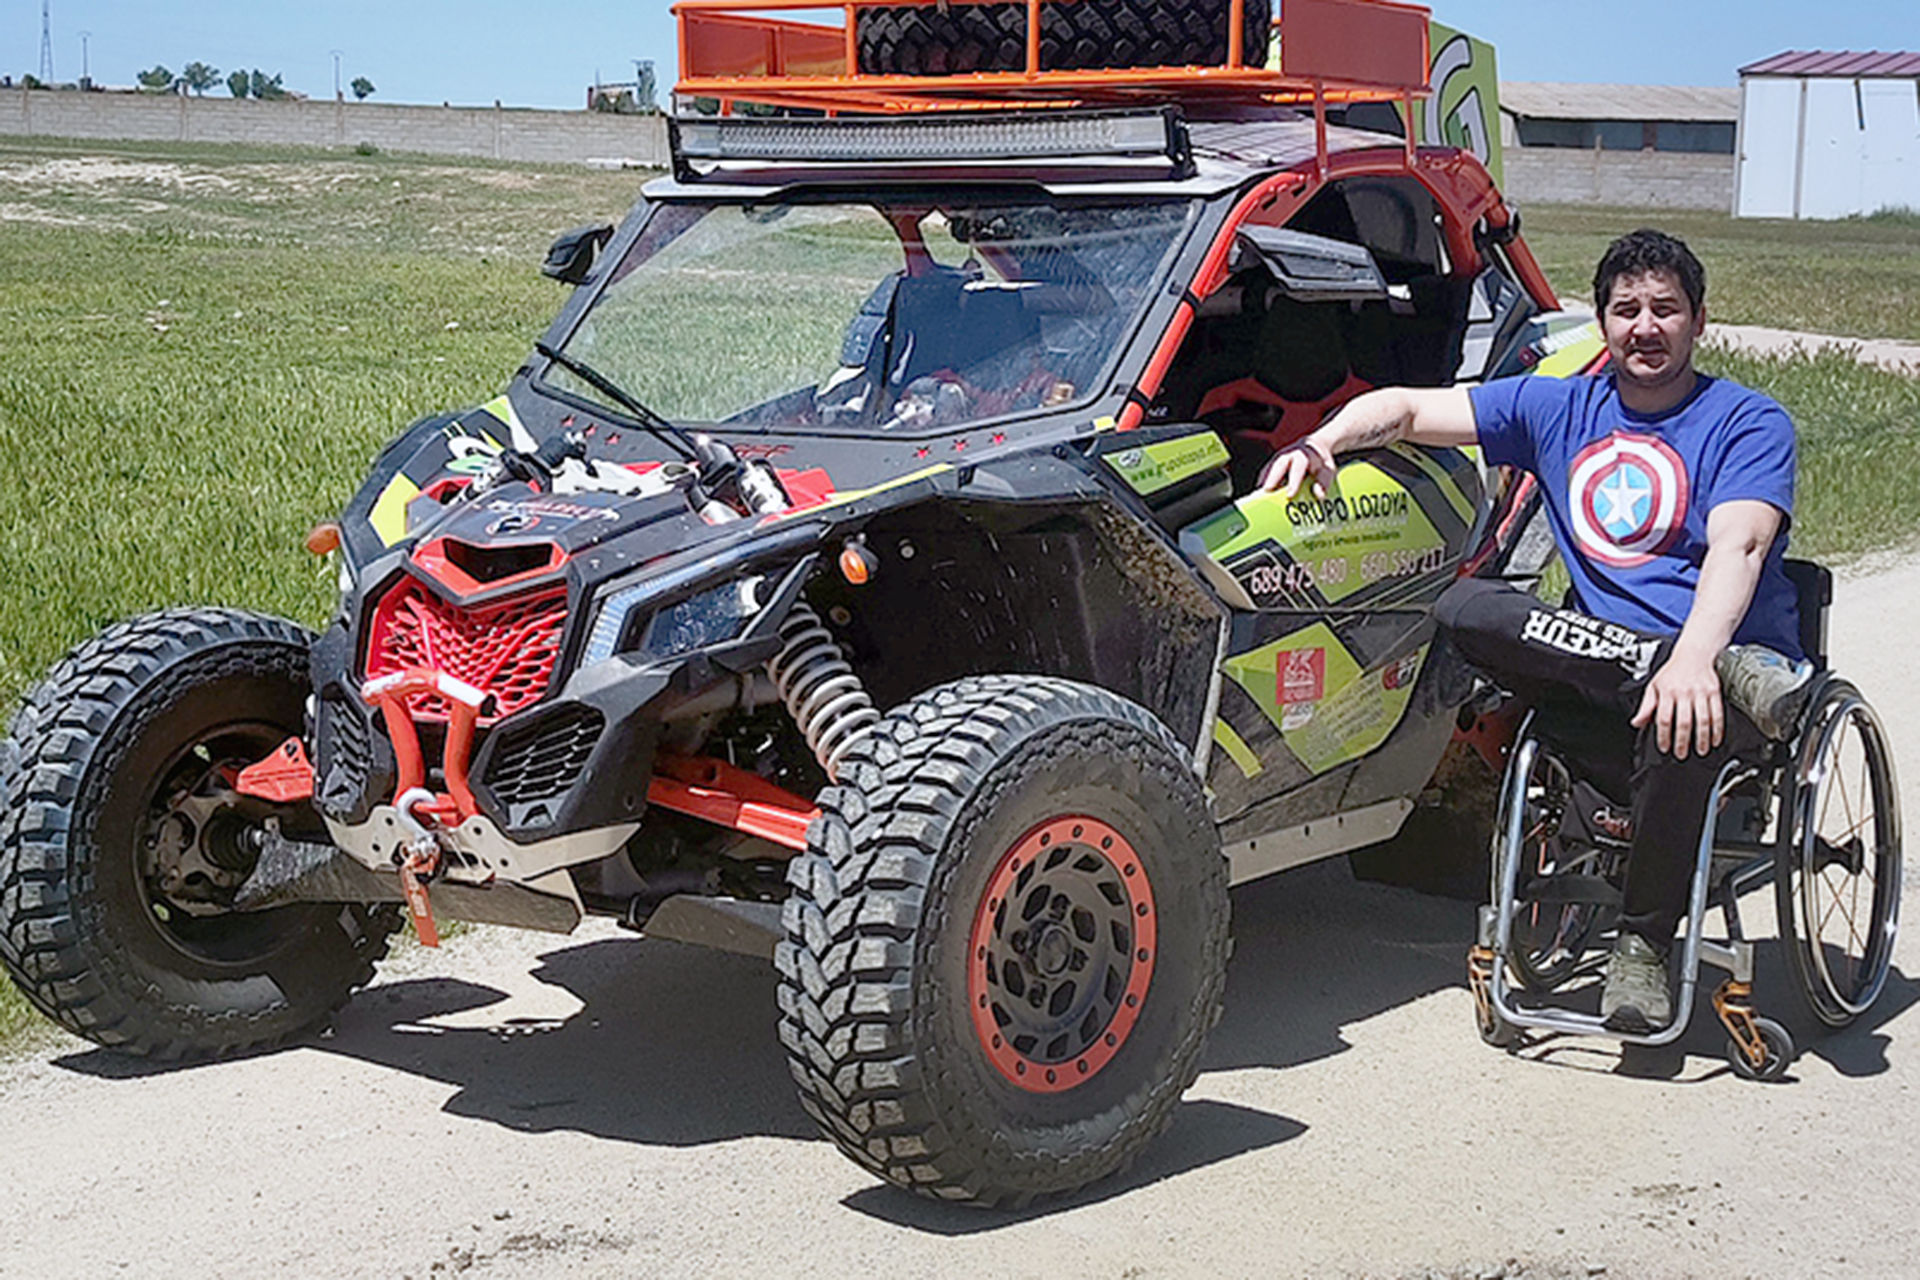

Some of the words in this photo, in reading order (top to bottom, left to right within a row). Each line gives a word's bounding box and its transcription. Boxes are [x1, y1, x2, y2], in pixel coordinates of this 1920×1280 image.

[1286, 496, 1348, 526] GRUPO
[1350, 492, 1408, 520] LOZOYA
[1251, 565, 1281, 595] 689
